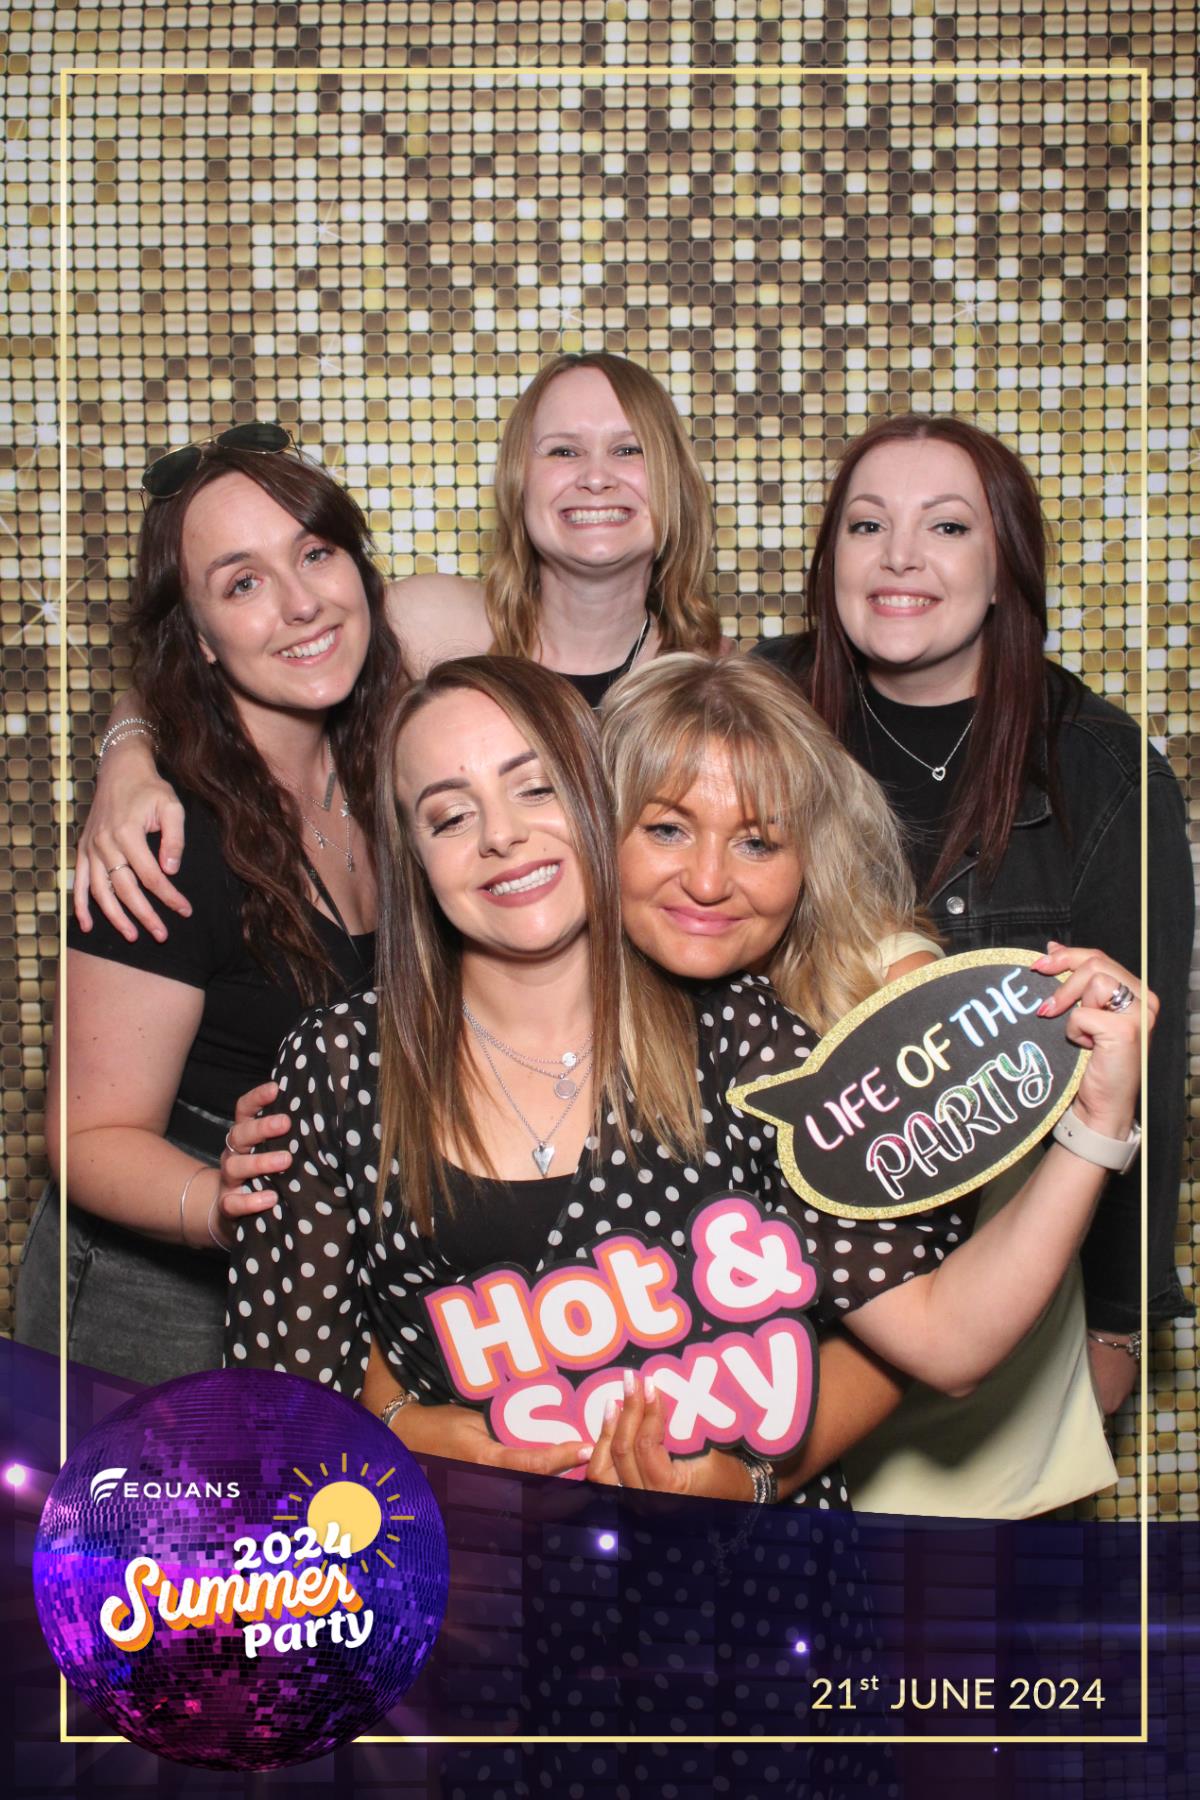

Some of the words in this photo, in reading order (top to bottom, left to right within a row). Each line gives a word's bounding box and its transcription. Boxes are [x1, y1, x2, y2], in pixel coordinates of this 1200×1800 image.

[805, 1066, 900, 1150] LIFE
[896, 1022, 951, 1088] OF
[949, 967, 1043, 1047] THE
[866, 1040, 1053, 1200] PARTY
[440, 1249, 678, 1387] Hot
[705, 1212, 802, 1308] &
